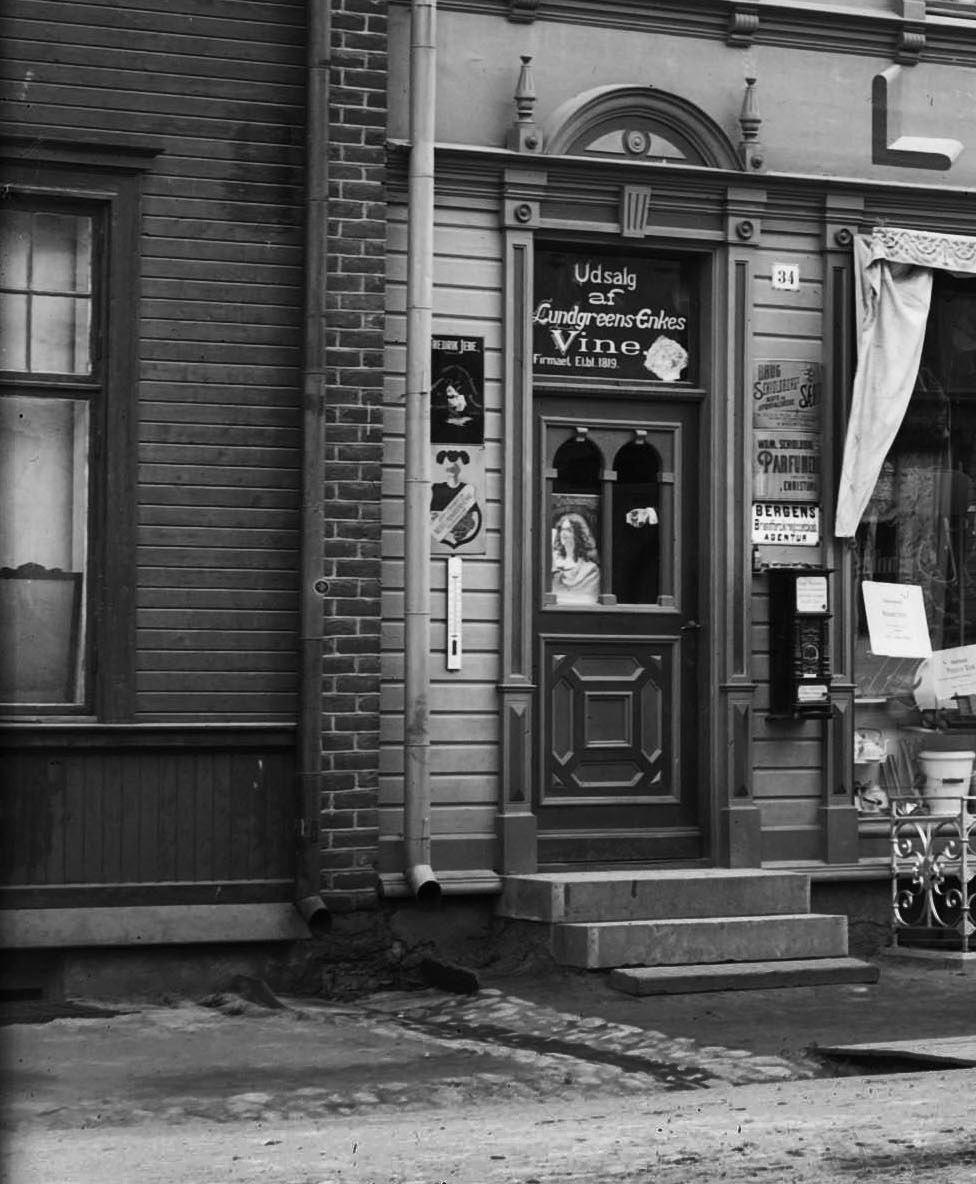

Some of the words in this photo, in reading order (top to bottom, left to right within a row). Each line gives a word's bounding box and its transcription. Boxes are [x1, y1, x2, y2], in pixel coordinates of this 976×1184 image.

[574, 263, 637, 291] Udsalg
[777, 270, 794, 286] 34
[588, 288, 625, 306] af
[755, 504, 816, 519] BERGENS
